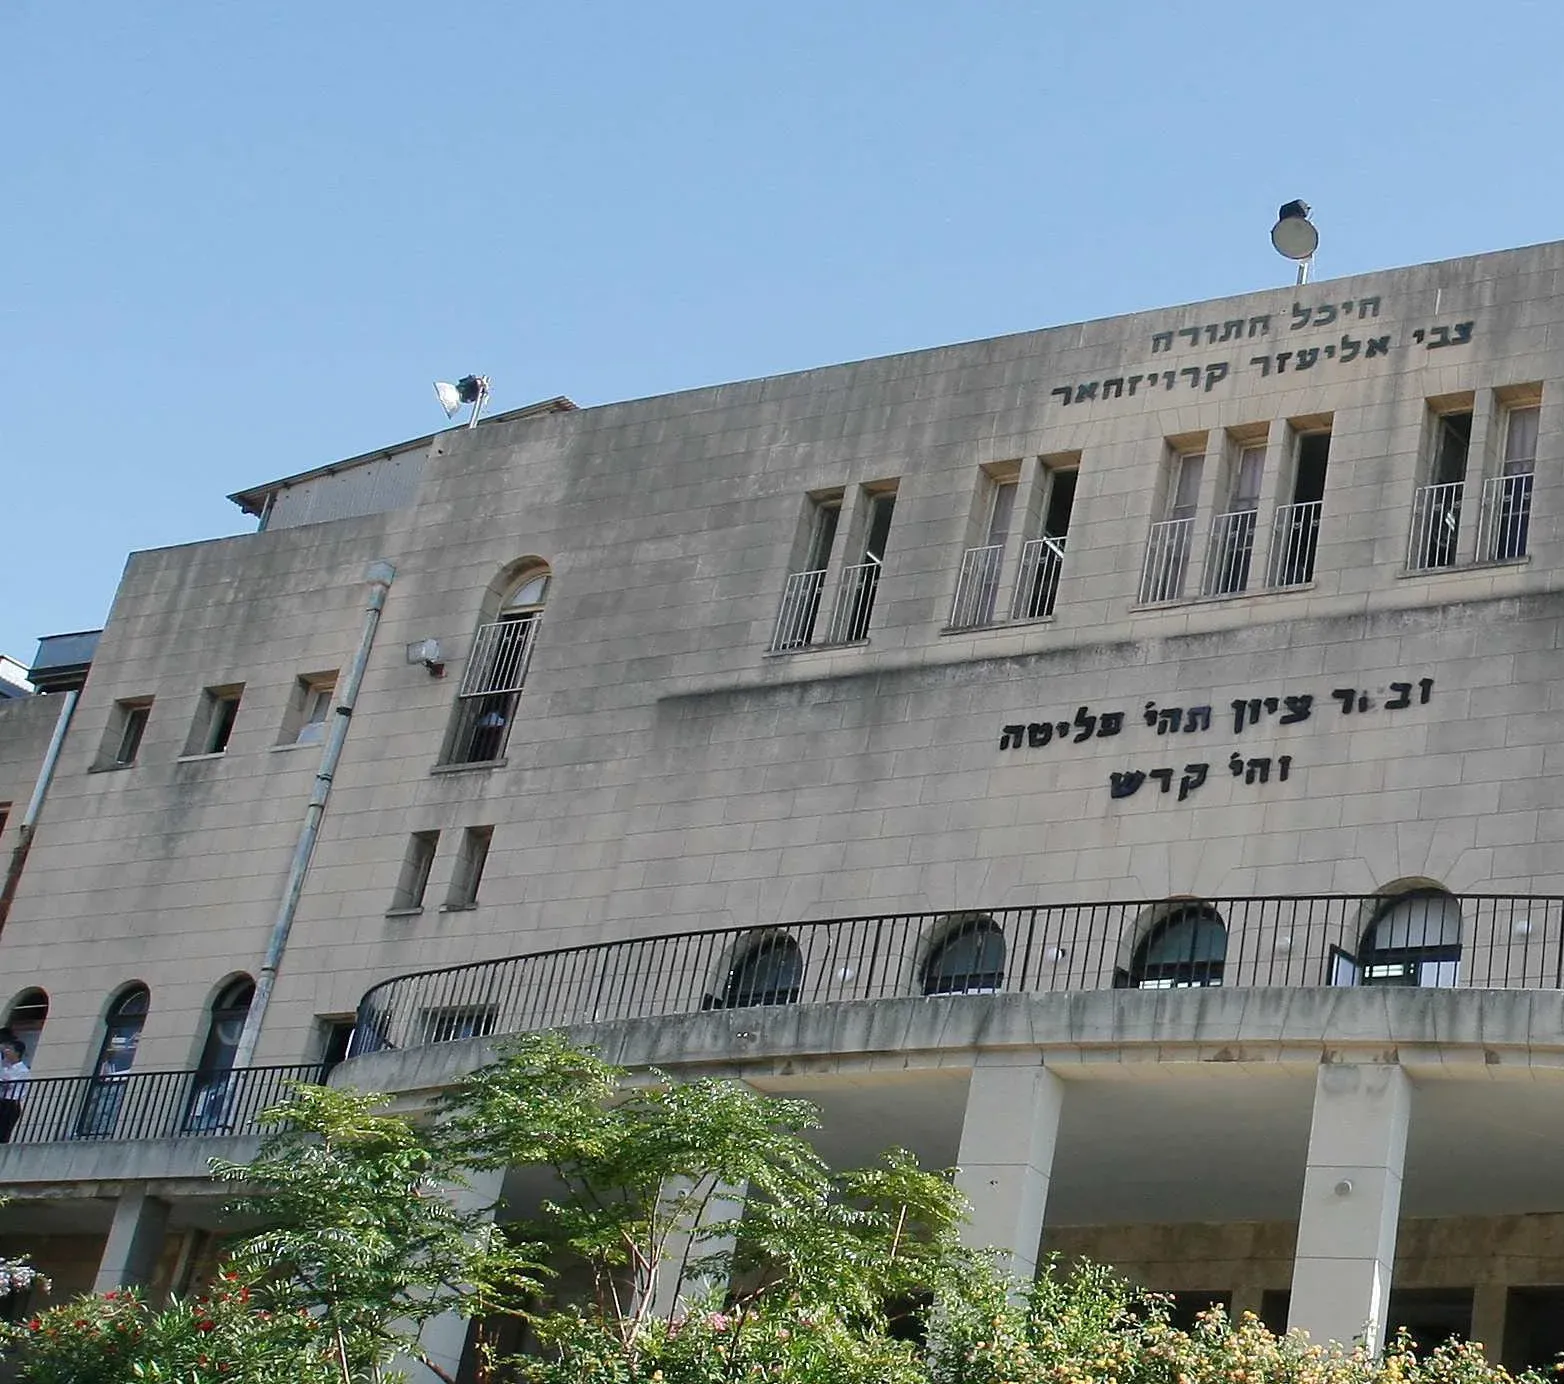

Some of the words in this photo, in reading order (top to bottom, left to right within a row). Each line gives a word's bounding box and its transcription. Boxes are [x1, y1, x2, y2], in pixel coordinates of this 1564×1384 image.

[1250, 334, 1392, 377] אליעזר
[1412, 320, 1475, 350] צבי
[999, 706, 1125, 751] פליטה
[1231, 693, 1314, 735] ציון
